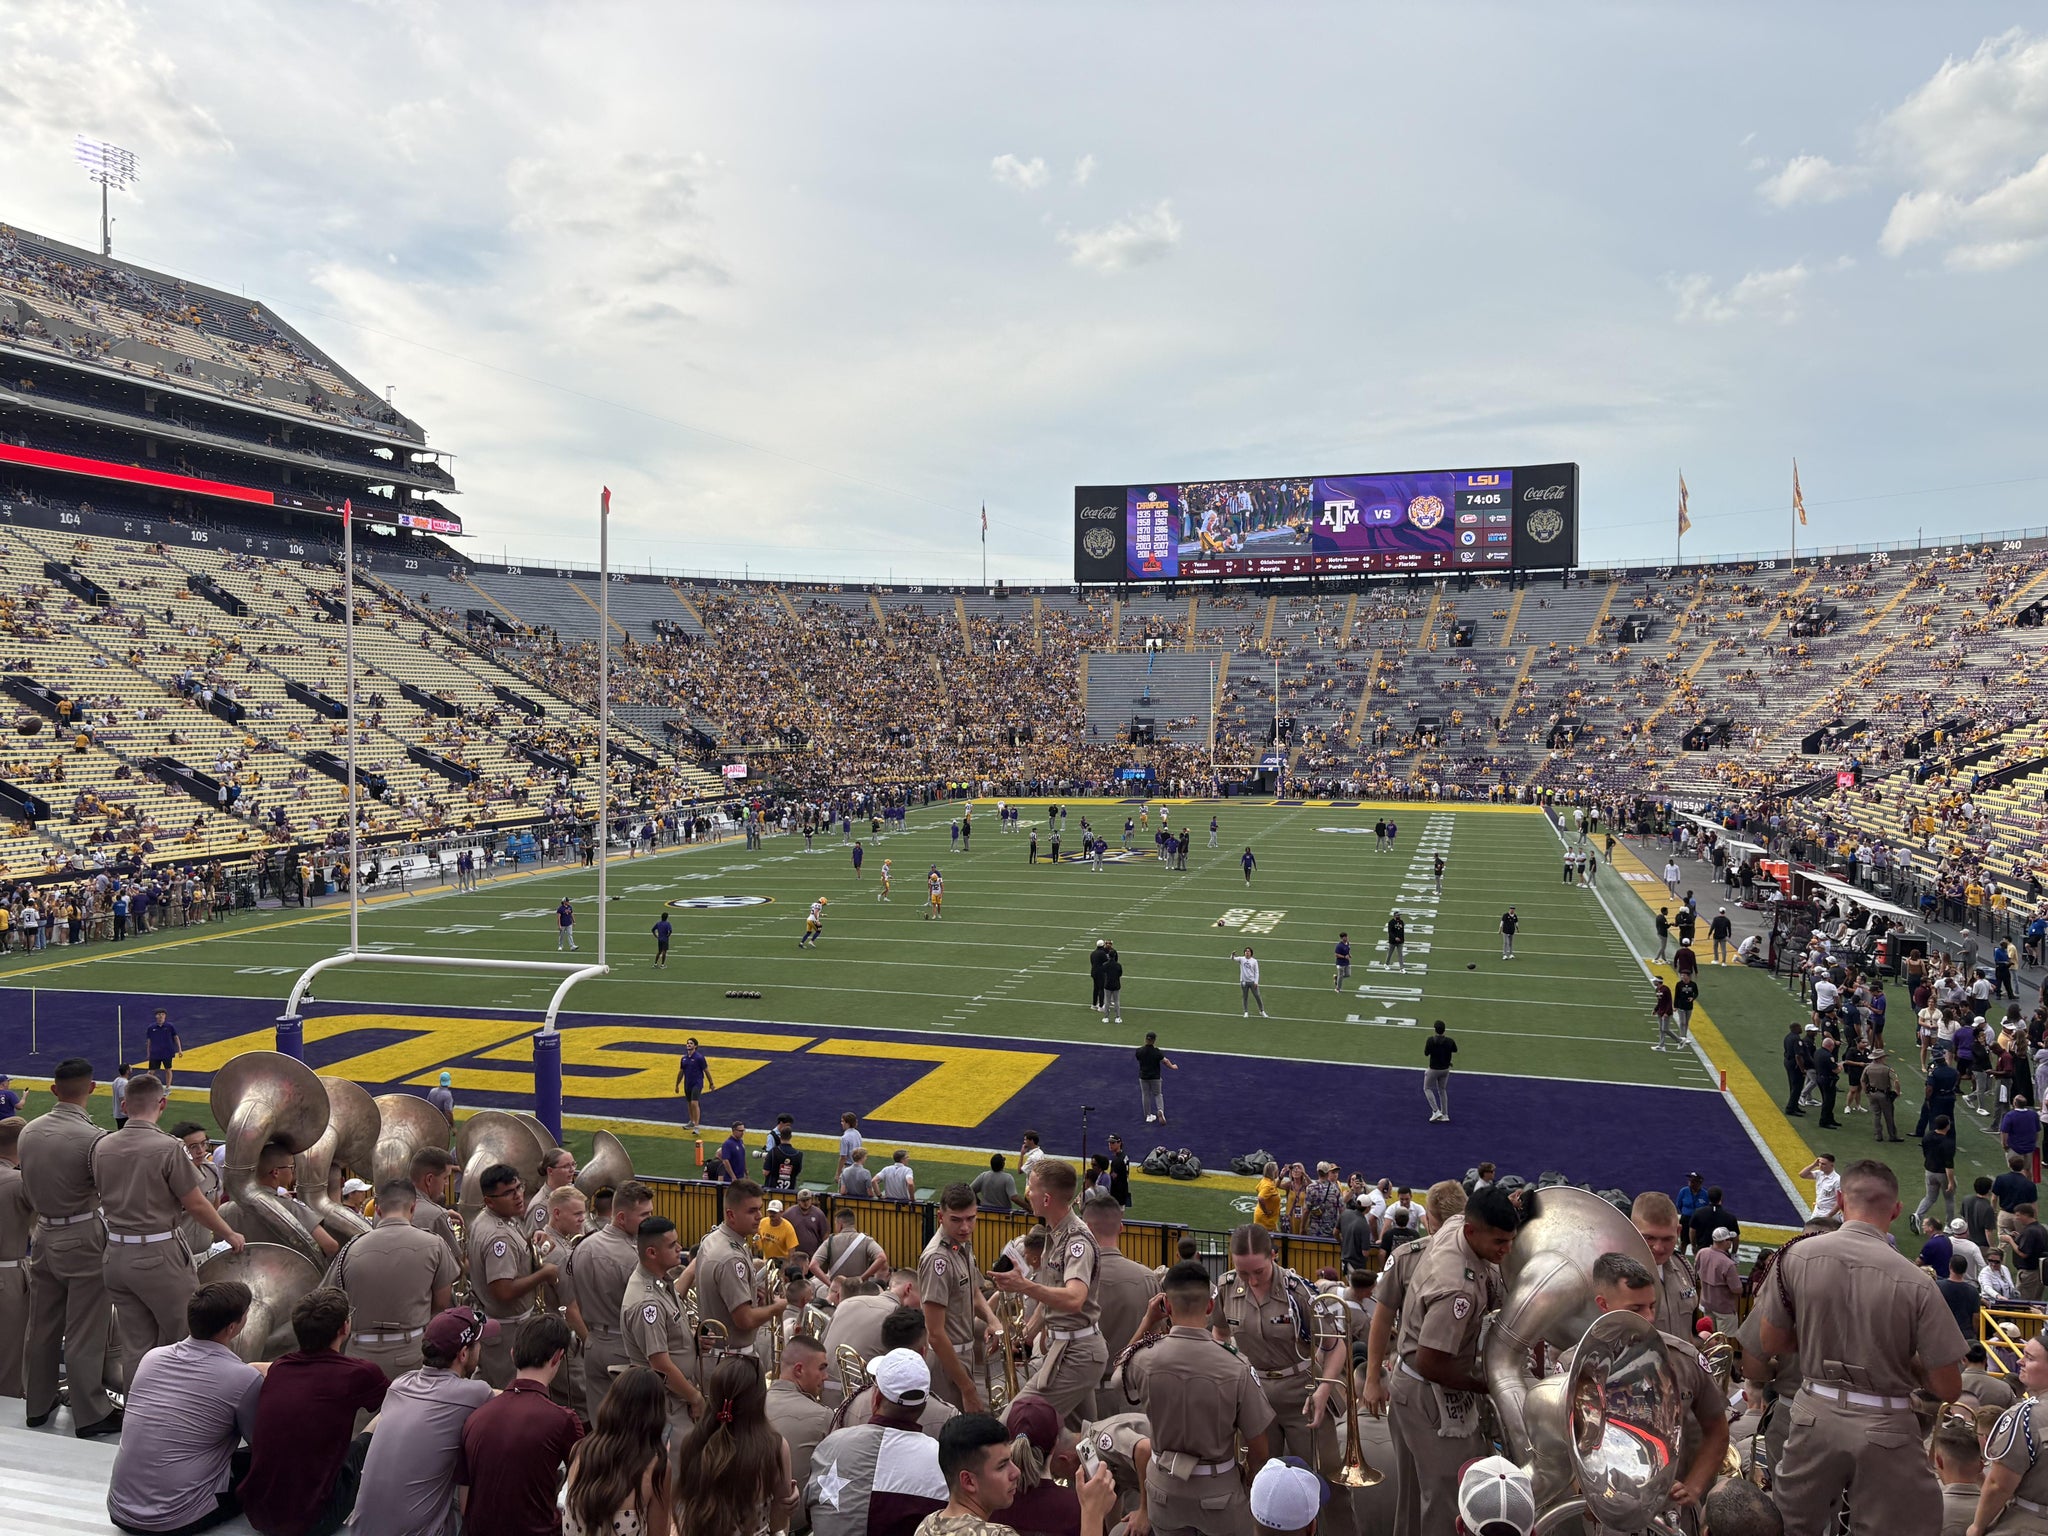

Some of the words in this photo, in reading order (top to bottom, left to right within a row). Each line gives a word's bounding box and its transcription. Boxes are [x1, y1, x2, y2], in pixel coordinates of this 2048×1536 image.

[1468, 475, 1499, 486] LSU
[1467, 494, 1501, 505] 74:05
[1136, 501, 1168, 509] CHAMPIONS
[1374, 509, 1391, 519] VS
[60, 513, 81, 525] 104
[191, 530, 208, 543] 105
[289, 544, 304, 555] 106
[2003, 541, 2022, 551] 240
[1870, 552, 1888, 562] 239
[405, 560, 418, 569] 223
[1758, 561, 1775, 570] 238
[507, 567, 521, 575] 224
[611, 574, 625, 582] 225
[908, 586, 923, 594] 228
[1279, 719, 1290, 727] 25
[26, 914, 30, 922] 3
[233, 966, 298, 975] 5
[776, 1180, 791, 1190] 32
